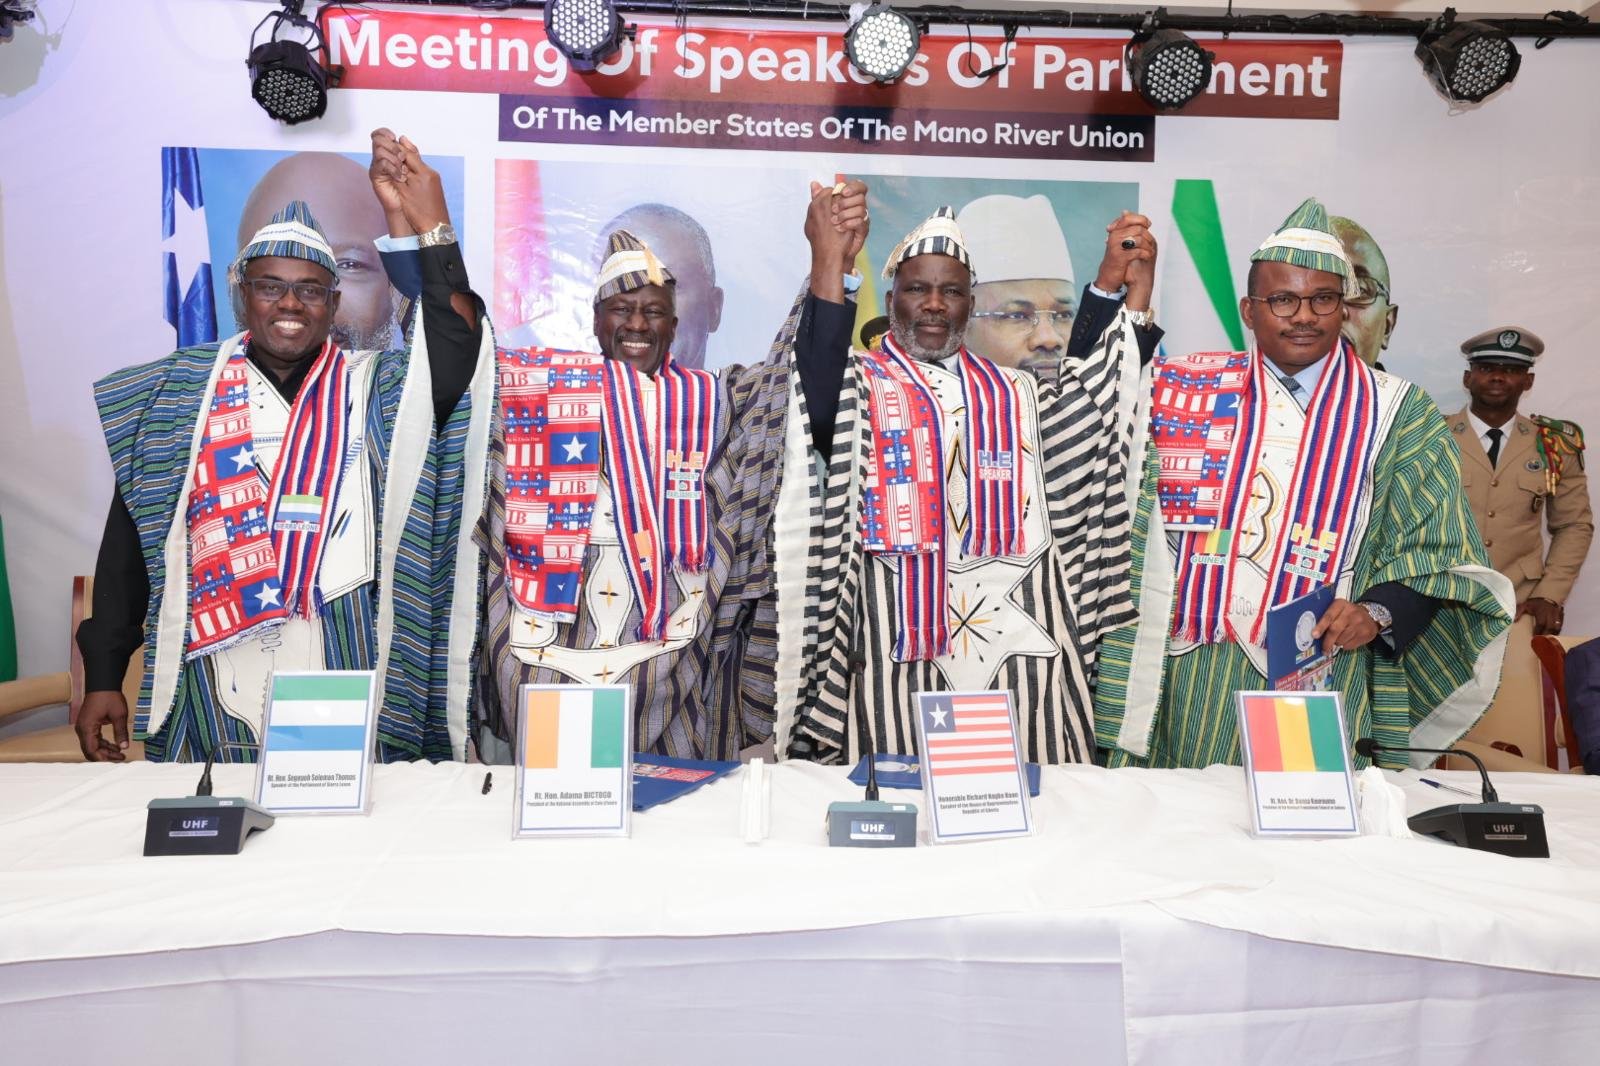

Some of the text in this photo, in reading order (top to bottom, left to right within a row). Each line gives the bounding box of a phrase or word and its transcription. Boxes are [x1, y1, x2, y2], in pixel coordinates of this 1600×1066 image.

[328, 18, 567, 87] Meeting
[673, 32, 930, 93] Speaks
[947, 41, 1017, 89] Of
[1033, 44, 1329, 97] Parlment
[512, 105, 1144, 148] Of The Member States Of The Mano River Union
[560, 403, 588, 417] LIB
[1162, 457, 1190, 470] LIB
[978, 468, 1012, 480] SPEAKER
[559, 480, 586, 495] LIB
[232, 486, 261, 506] LIB
[897, 503, 913, 533] LIB
[244, 547, 274, 569] LIB
[1191, 555, 1226, 565] GUINEA
[560, 791, 583, 799] Adama
[182, 820, 209, 829] UHF
[860, 823, 885, 833] UHF
[1492, 824, 1515, 833] UHF
